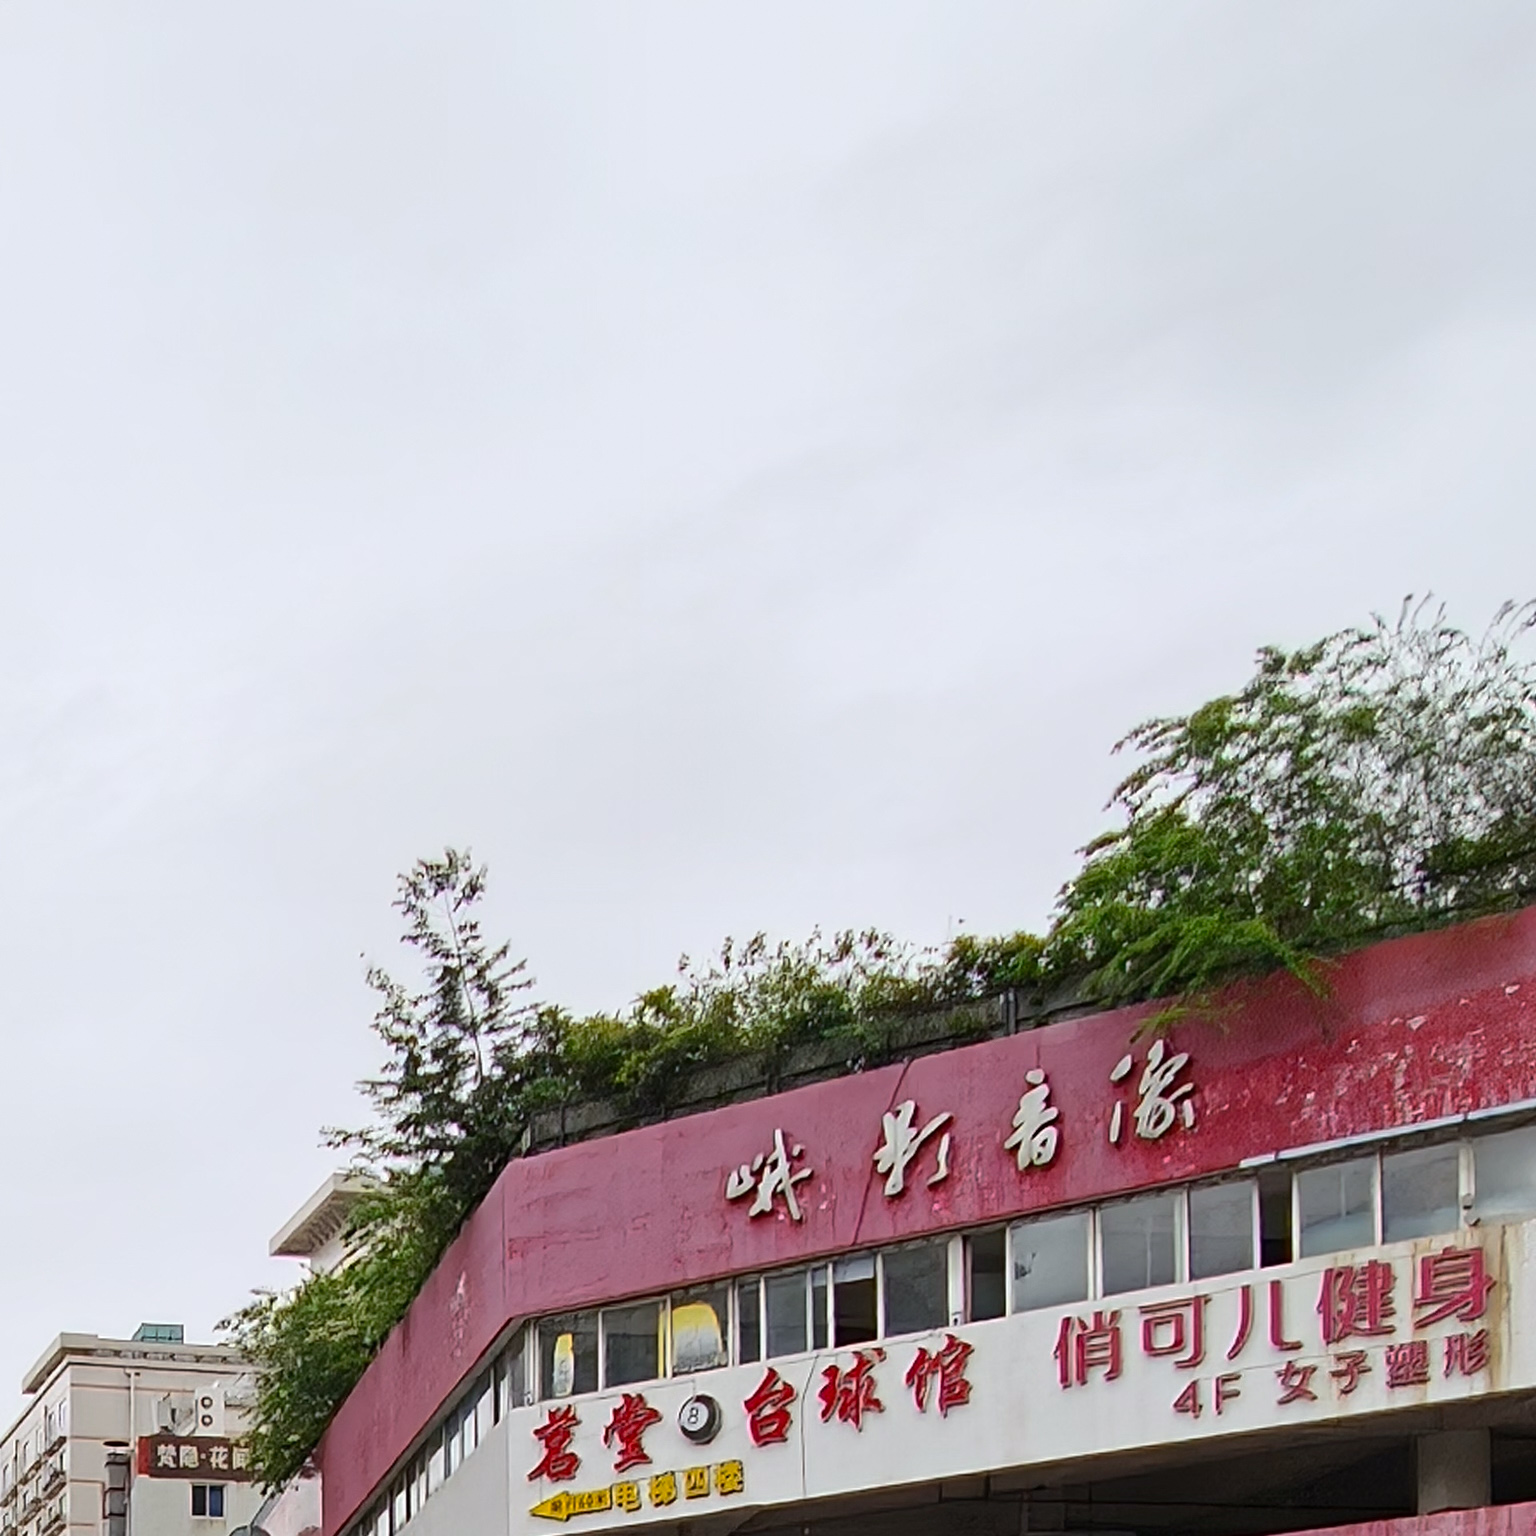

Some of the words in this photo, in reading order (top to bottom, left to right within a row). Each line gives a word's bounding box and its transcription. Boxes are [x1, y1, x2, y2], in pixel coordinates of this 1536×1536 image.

[1053, 1244, 1497, 1390] 俏可儿健身
[742, 1332, 977, 1447] 台球馆
[1173, 1375, 1239, 1419] 4F
[1275, 1328, 1491, 1404] 女子塑形
[615, 1460, 744, 1512] 电梯四楼
